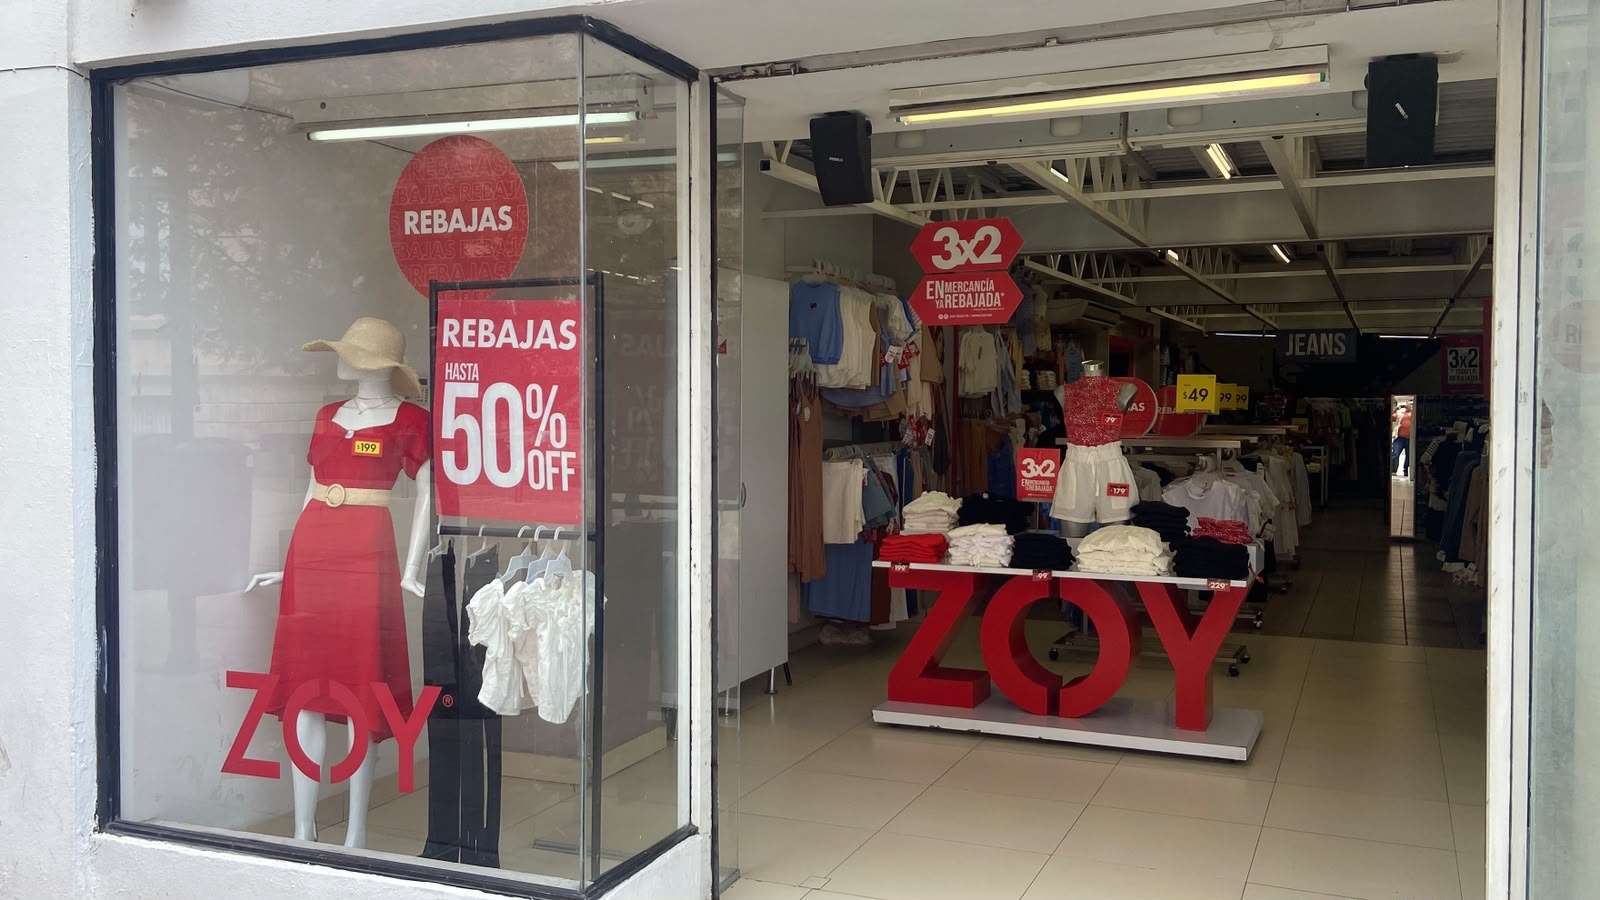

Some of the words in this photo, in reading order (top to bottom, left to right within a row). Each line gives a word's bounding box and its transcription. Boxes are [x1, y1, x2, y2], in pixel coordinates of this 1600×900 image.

[404, 205, 513, 235] REBAJAS
[931, 226, 1002, 270] 3x2
[926, 280, 945, 300] EN
[945, 278, 995, 293] MERCANCÍA
[442, 318, 577, 350] REBAJAS
[1285, 332, 1346, 357] JEANS
[445, 362, 480, 381] HASTA
[1449, 348, 1478, 369] 3x2
[1183, 387, 1209, 402] $49
[528, 448, 577, 491] OFF
[1021, 457, 1056, 478] 3x2
[888, 565, 1249, 732] ZOY
[220, 670, 443, 794] ZOY
